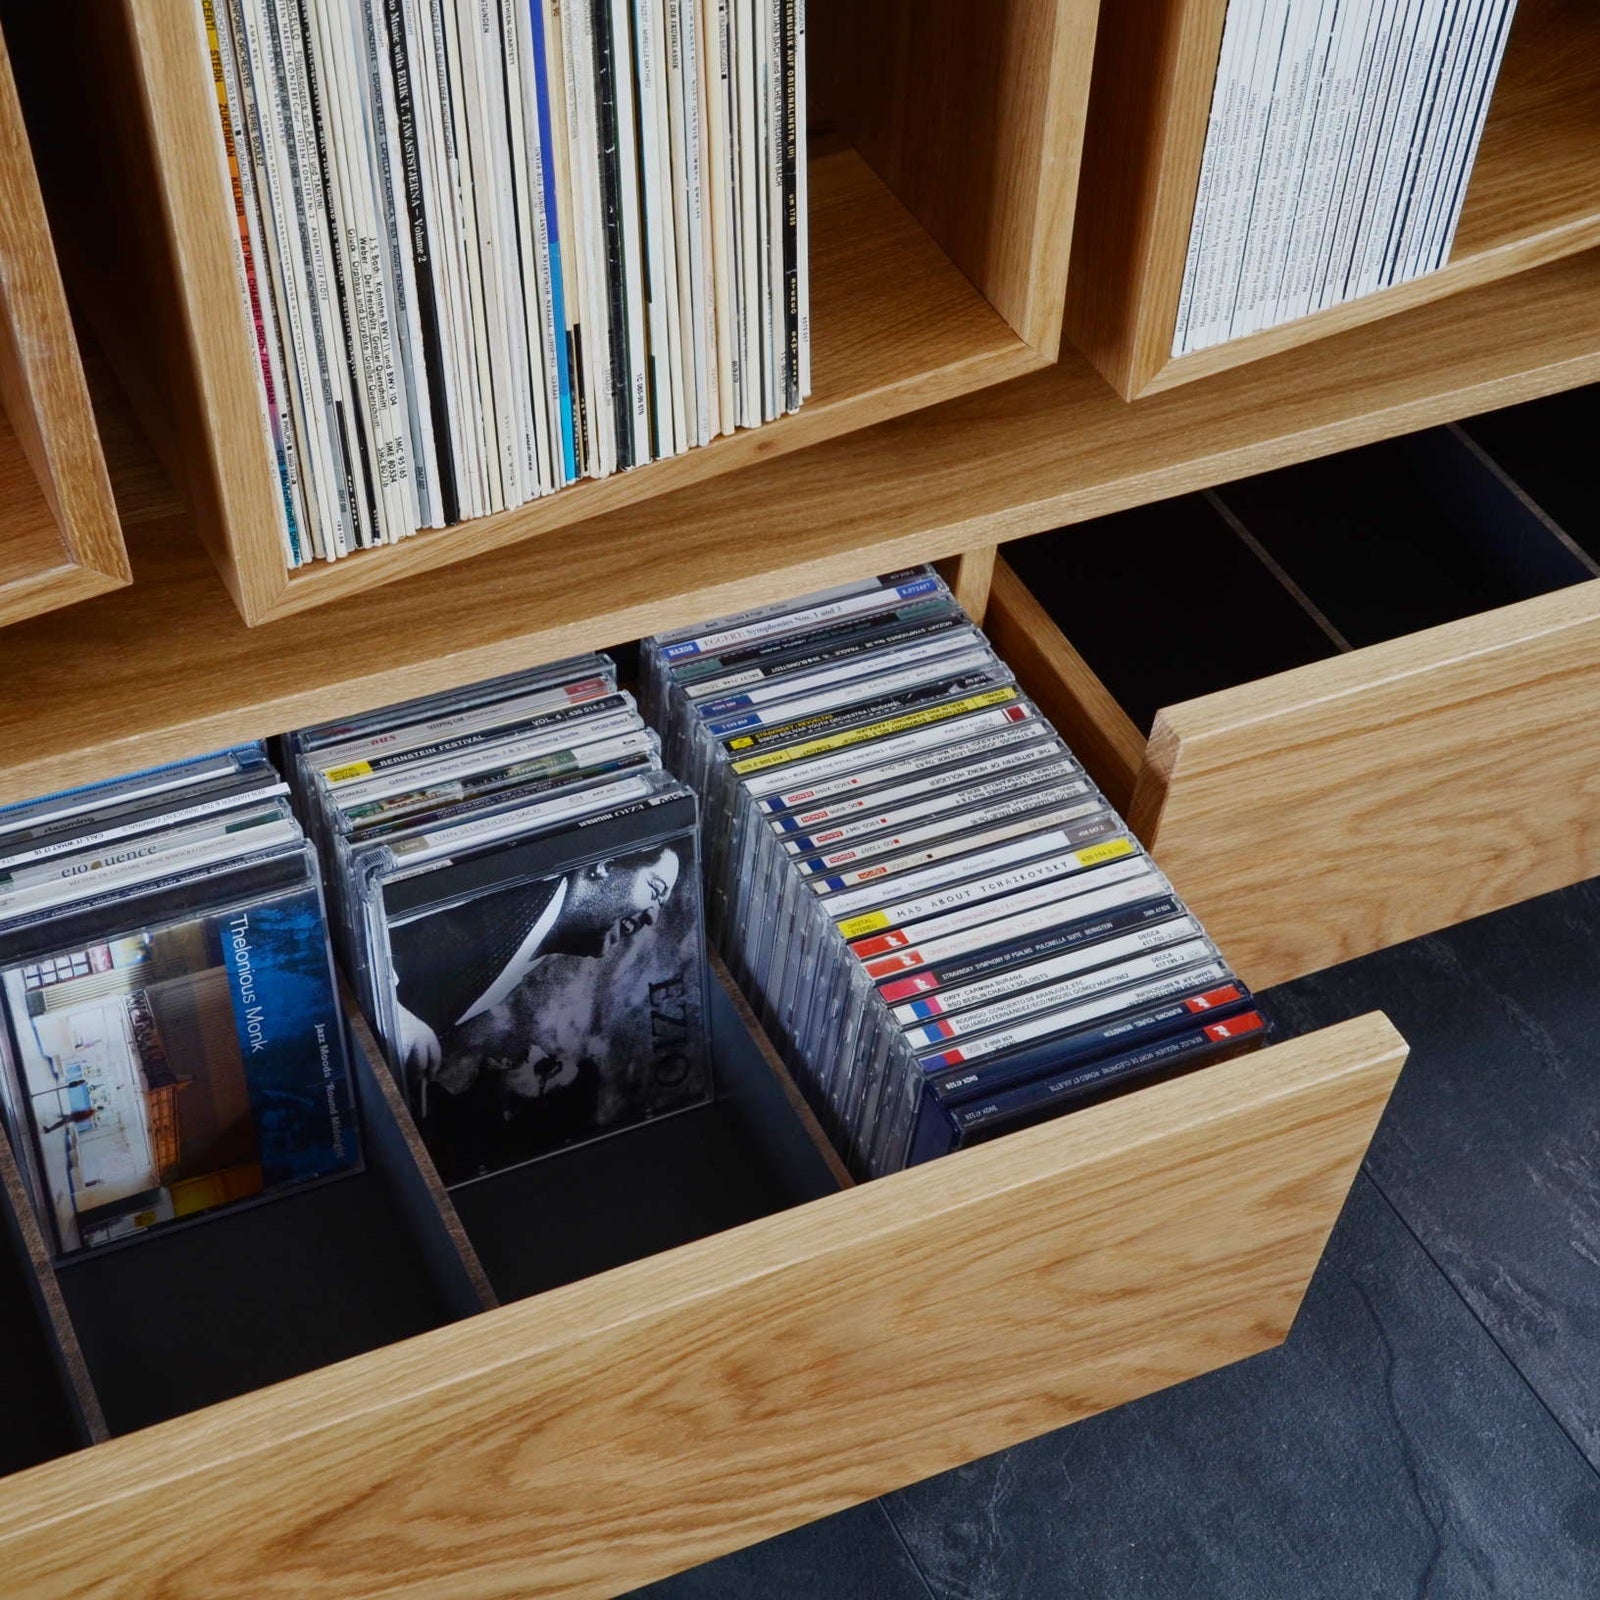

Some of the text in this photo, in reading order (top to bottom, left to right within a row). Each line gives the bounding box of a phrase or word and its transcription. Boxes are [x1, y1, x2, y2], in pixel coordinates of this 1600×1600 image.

[388, 12, 402, 42] Music
[668, 4, 679, 69] DER FRÜHKLASSIK
[208, 49, 223, 82] STERN
[235, 36, 252, 88] ORCHESTER
[391, 44, 405, 68] with
[785, 49, 793, 66] AUF
[394, 69, 408, 98] ERIK
[246, 103, 259, 134] PIERRE
[301, 113, 312, 128] von
[374, 105, 386, 136] MELKUS
[398, 102, 410, 112] T.
[771, 36, 783, 186] BACH und WILHELM FRIEDEMANN BACH
[217, 102, 236, 157] ZUKERMAN
[305, 129, 317, 159] PLATTI
[251, 135, 264, 167] BOULEZ
[379, 141, 390, 174] CAPELLA
[399, 112, 421, 207] TAWASTSTJERNA
[309, 160, 320, 176] und
[230, 176, 246, 217] KILLMER
[311, 177, 324, 210] TARTINI
[383, 176, 396, 219] ACADEMICA,
[388, 221, 398, 238] WIEN
[411, 218, 426, 254] Volume
[242, 250, 255, 273] PAUL
[293, 185, 305, 216] NICOLET
[320, 378, 332, 406] RICHTER
[1182, 266, 1194, 296] analoges
[246, 277, 262, 321] CHAMBER
[373, 281, 387, 318] Kantaten
[1181, 295, 1189, 306] für
[378, 320, 390, 340] BWV
[1176, 307, 1187, 332] Magazin
[345, 228, 387, 464] Gluck Orpheus und Eurydike SMC
[357, 236, 395, 458] Weber Der Freischütz SME
[383, 353, 394, 369] und
[259, 357, 276, 405] ZUKERMAN
[385, 371, 397, 392] BWV
[280, 419, 292, 445] PHILIPS
[393, 435, 405, 454] SMC
[274, 448, 286, 467] CBS
[667, 643, 694, 656] NAXOS
[745, 617, 793, 637] Symphonies
[819, 606, 834, 616] and
[379, 746, 436, 767] BERNSTEIN
[438, 733, 485, 752] FESTIVAL
[531, 714, 557, 727] VOL.
[1036, 745, 1050, 755] THE
[965, 764, 988, 776] HEINZ
[988, 760, 1000, 769] OF
[1000, 750, 1035, 766] ARTISTRY
[787, 790, 813, 802] DENON
[800, 810, 827, 823] DENON
[816, 829, 842, 842] DENON
[828, 850, 855, 863] DENON
[896, 860, 1068, 918] MAD ABOUT TCHAIKOVSKY
[1137, 928, 1160, 941] DECCA
[941, 920, 1113, 981] STRAVINSKY SYMPHONY OF PSALMS PULCINELLA SUITE BERNSTEIN
[1150, 951, 1172, 963] DECCA
[228, 913, 268, 1053] Thelonious Monk
[962, 981, 994, 996] CARMINA
[986, 999, 1020, 1016] CONCIERTO
[648, 975, 693, 1090] EZIO
[1103, 1022, 1133, 1038] BERNSTEIN
[1047, 1035, 1203, 1092] BERLIOZ REQUIEM MORT DE ET JULIETTE
[314, 1022, 345, 1158] Jazz Moods 'Round Midnight
